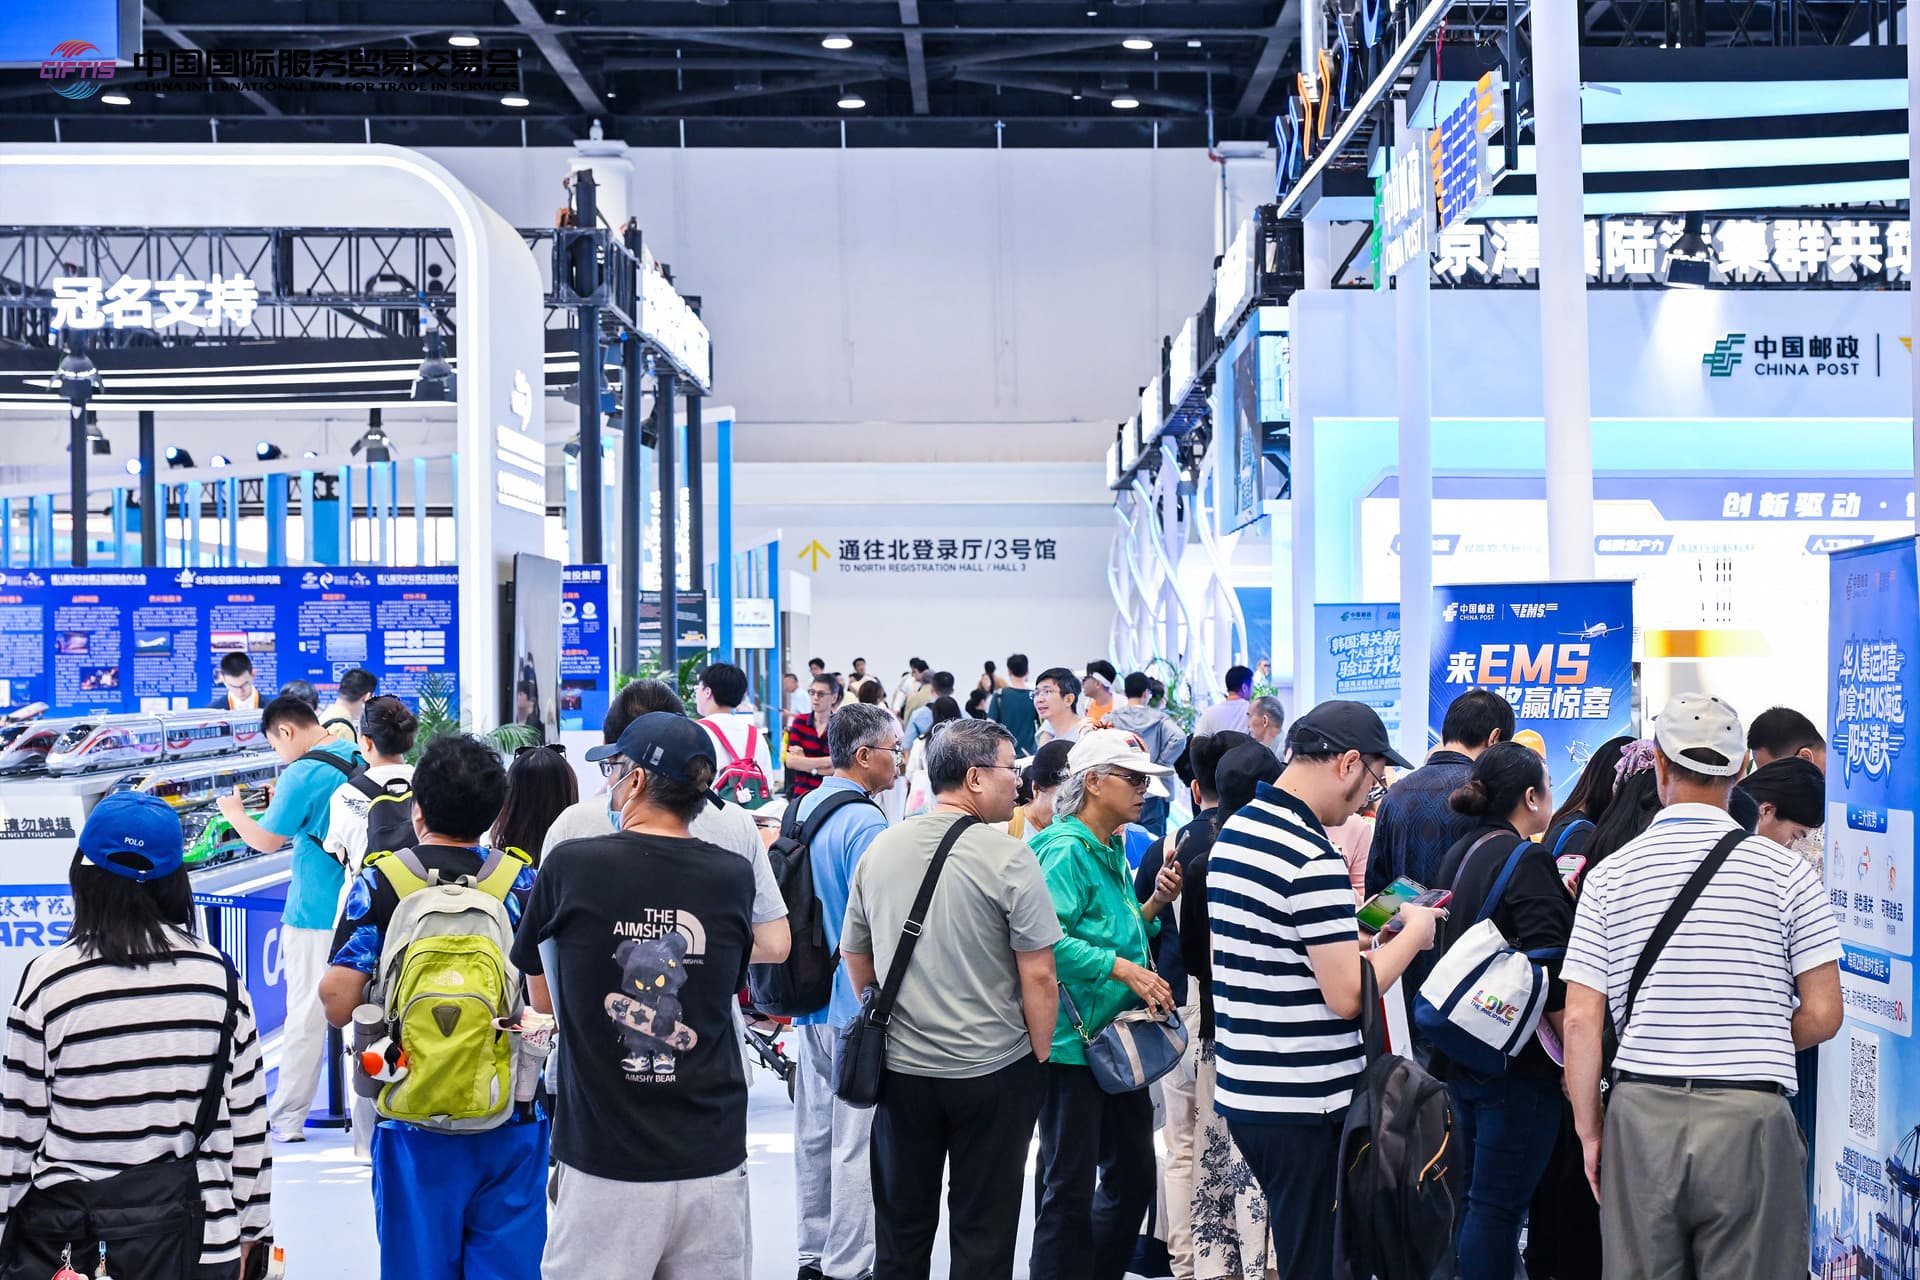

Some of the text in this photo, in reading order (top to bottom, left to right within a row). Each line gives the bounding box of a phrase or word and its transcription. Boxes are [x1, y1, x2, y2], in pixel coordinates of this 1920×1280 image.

[52, 274, 258, 329] 冠名支持
[1755, 335, 1860, 359] 中国邮政
[1755, 363, 1860, 376] CHINA POST
[839, 538, 1056, 561] 通往北登录厅/3号馆
[840, 564, 850, 572] TO
[854, 564, 886, 572] NORTH
[889, 564, 956, 572] REGISTRATION
[959, 564, 983, 572] HALL
[993, 564, 1017, 572] HALL
[1021, 564, 1026, 572] 3
[1460, 604, 1495, 614] 中国邮政
[1518, 604, 1547, 618] EMS
[1466, 686, 1612, 719] 奖赢惊喜
[124, 836, 144, 847] POLO
[644, 908, 674, 924] THE
[1472, 989, 1520, 1021] LOVE
[625, 1074, 653, 1082] AIMSHY
